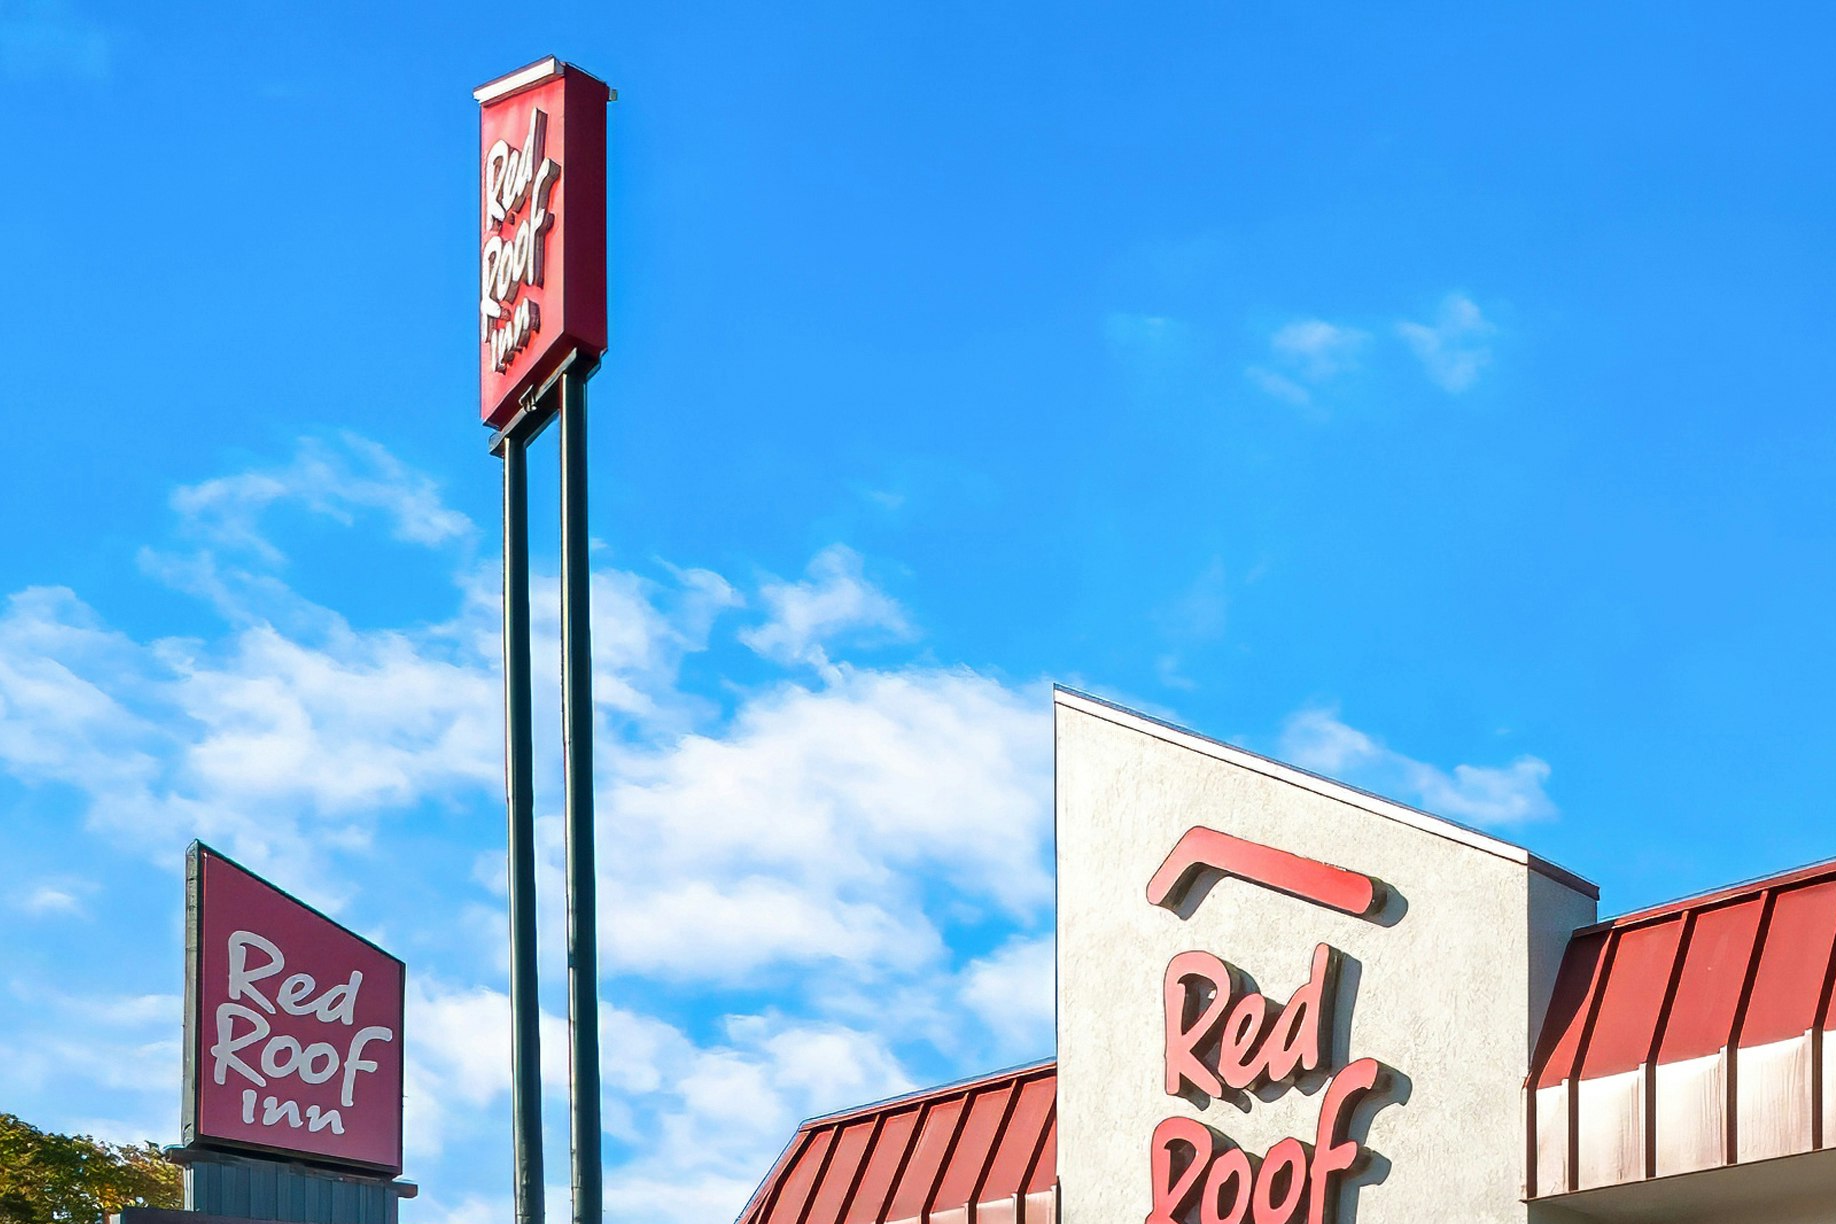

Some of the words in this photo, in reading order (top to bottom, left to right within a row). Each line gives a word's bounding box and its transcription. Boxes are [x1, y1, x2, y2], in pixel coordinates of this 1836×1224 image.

[486, 107, 544, 231] Red
[480, 157, 559, 342] Roof
[227, 930, 363, 1025] Red
[1163, 942, 1333, 1099] Red
[210, 1002, 393, 1107] Roof
[242, 1089, 345, 1135] Inn
